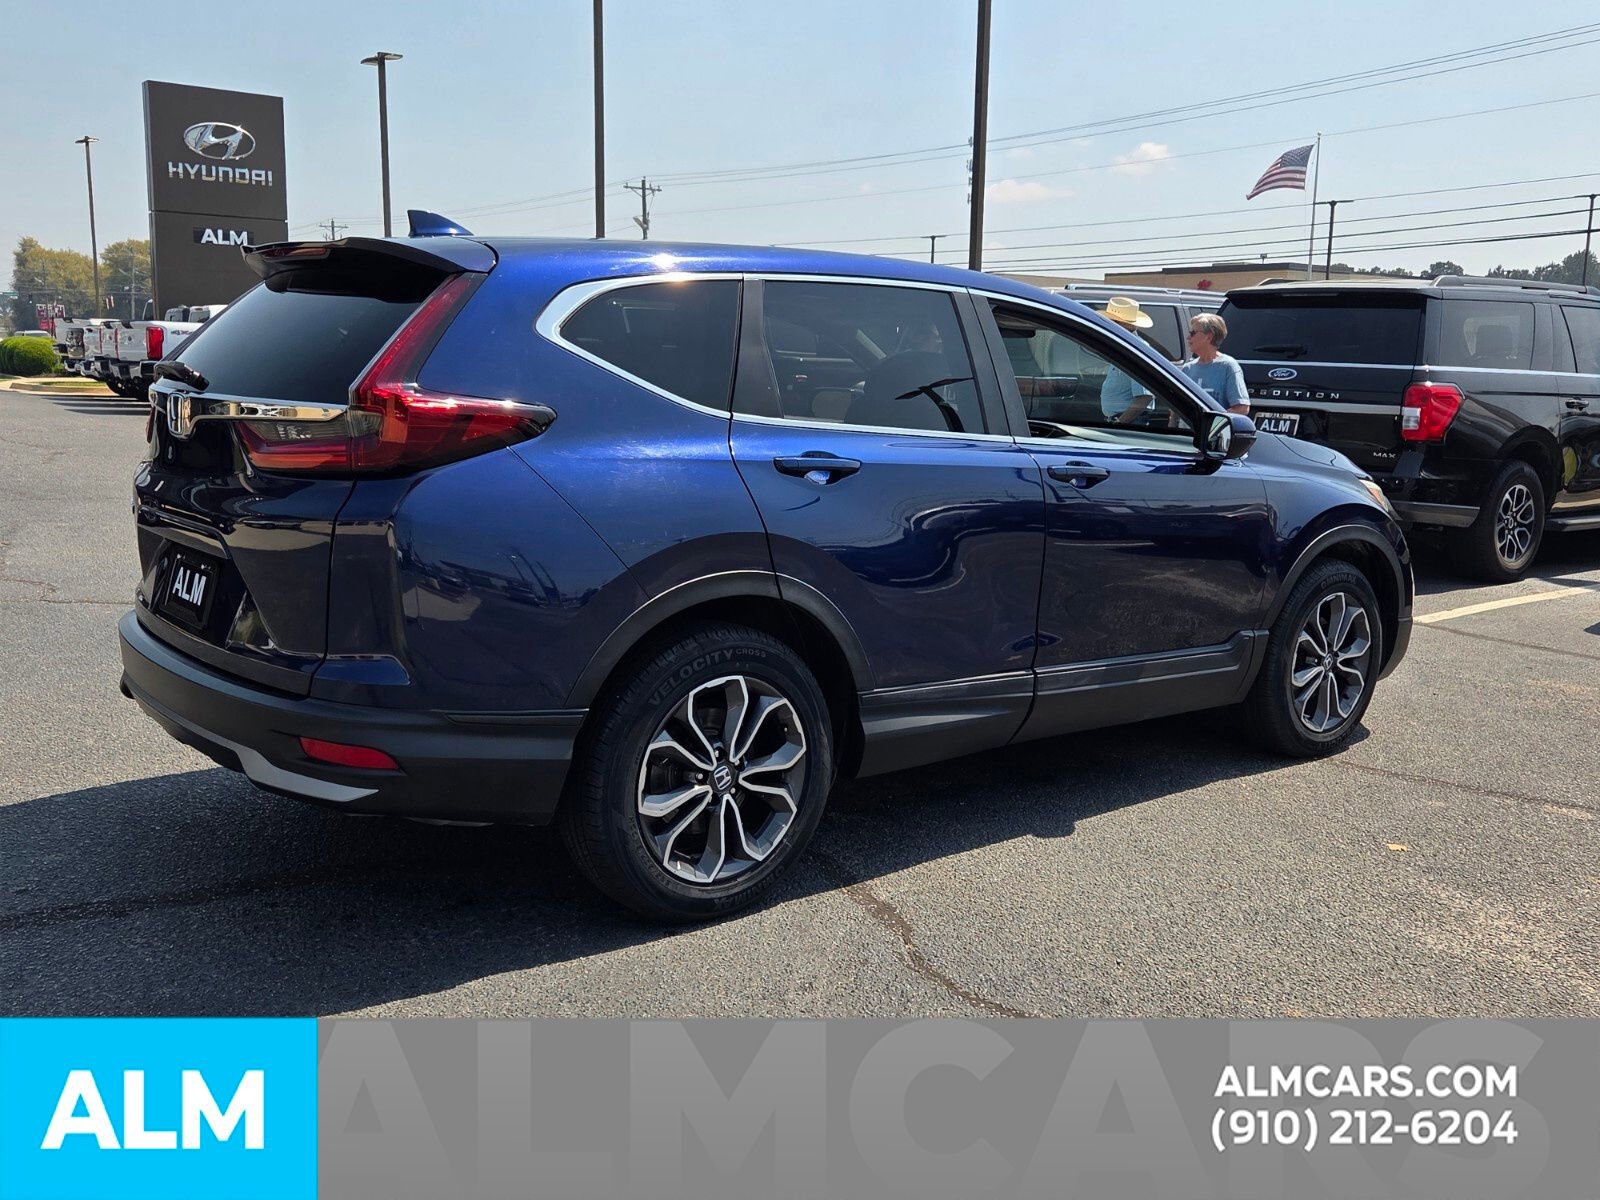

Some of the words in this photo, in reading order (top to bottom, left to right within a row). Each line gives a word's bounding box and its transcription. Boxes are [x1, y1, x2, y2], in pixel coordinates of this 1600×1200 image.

[167, 161, 273, 187] HYUNDAI
[200, 228, 249, 246] ALM
[1271, 368, 1293, 378] Ford
[1259, 418, 1291, 434] ALM
[1372, 451, 1396, 459] MAX
[171, 565, 207, 606] ALM
[647, 647, 734, 706] VELOCITY
[735, 647, 767, 659] CROSS
